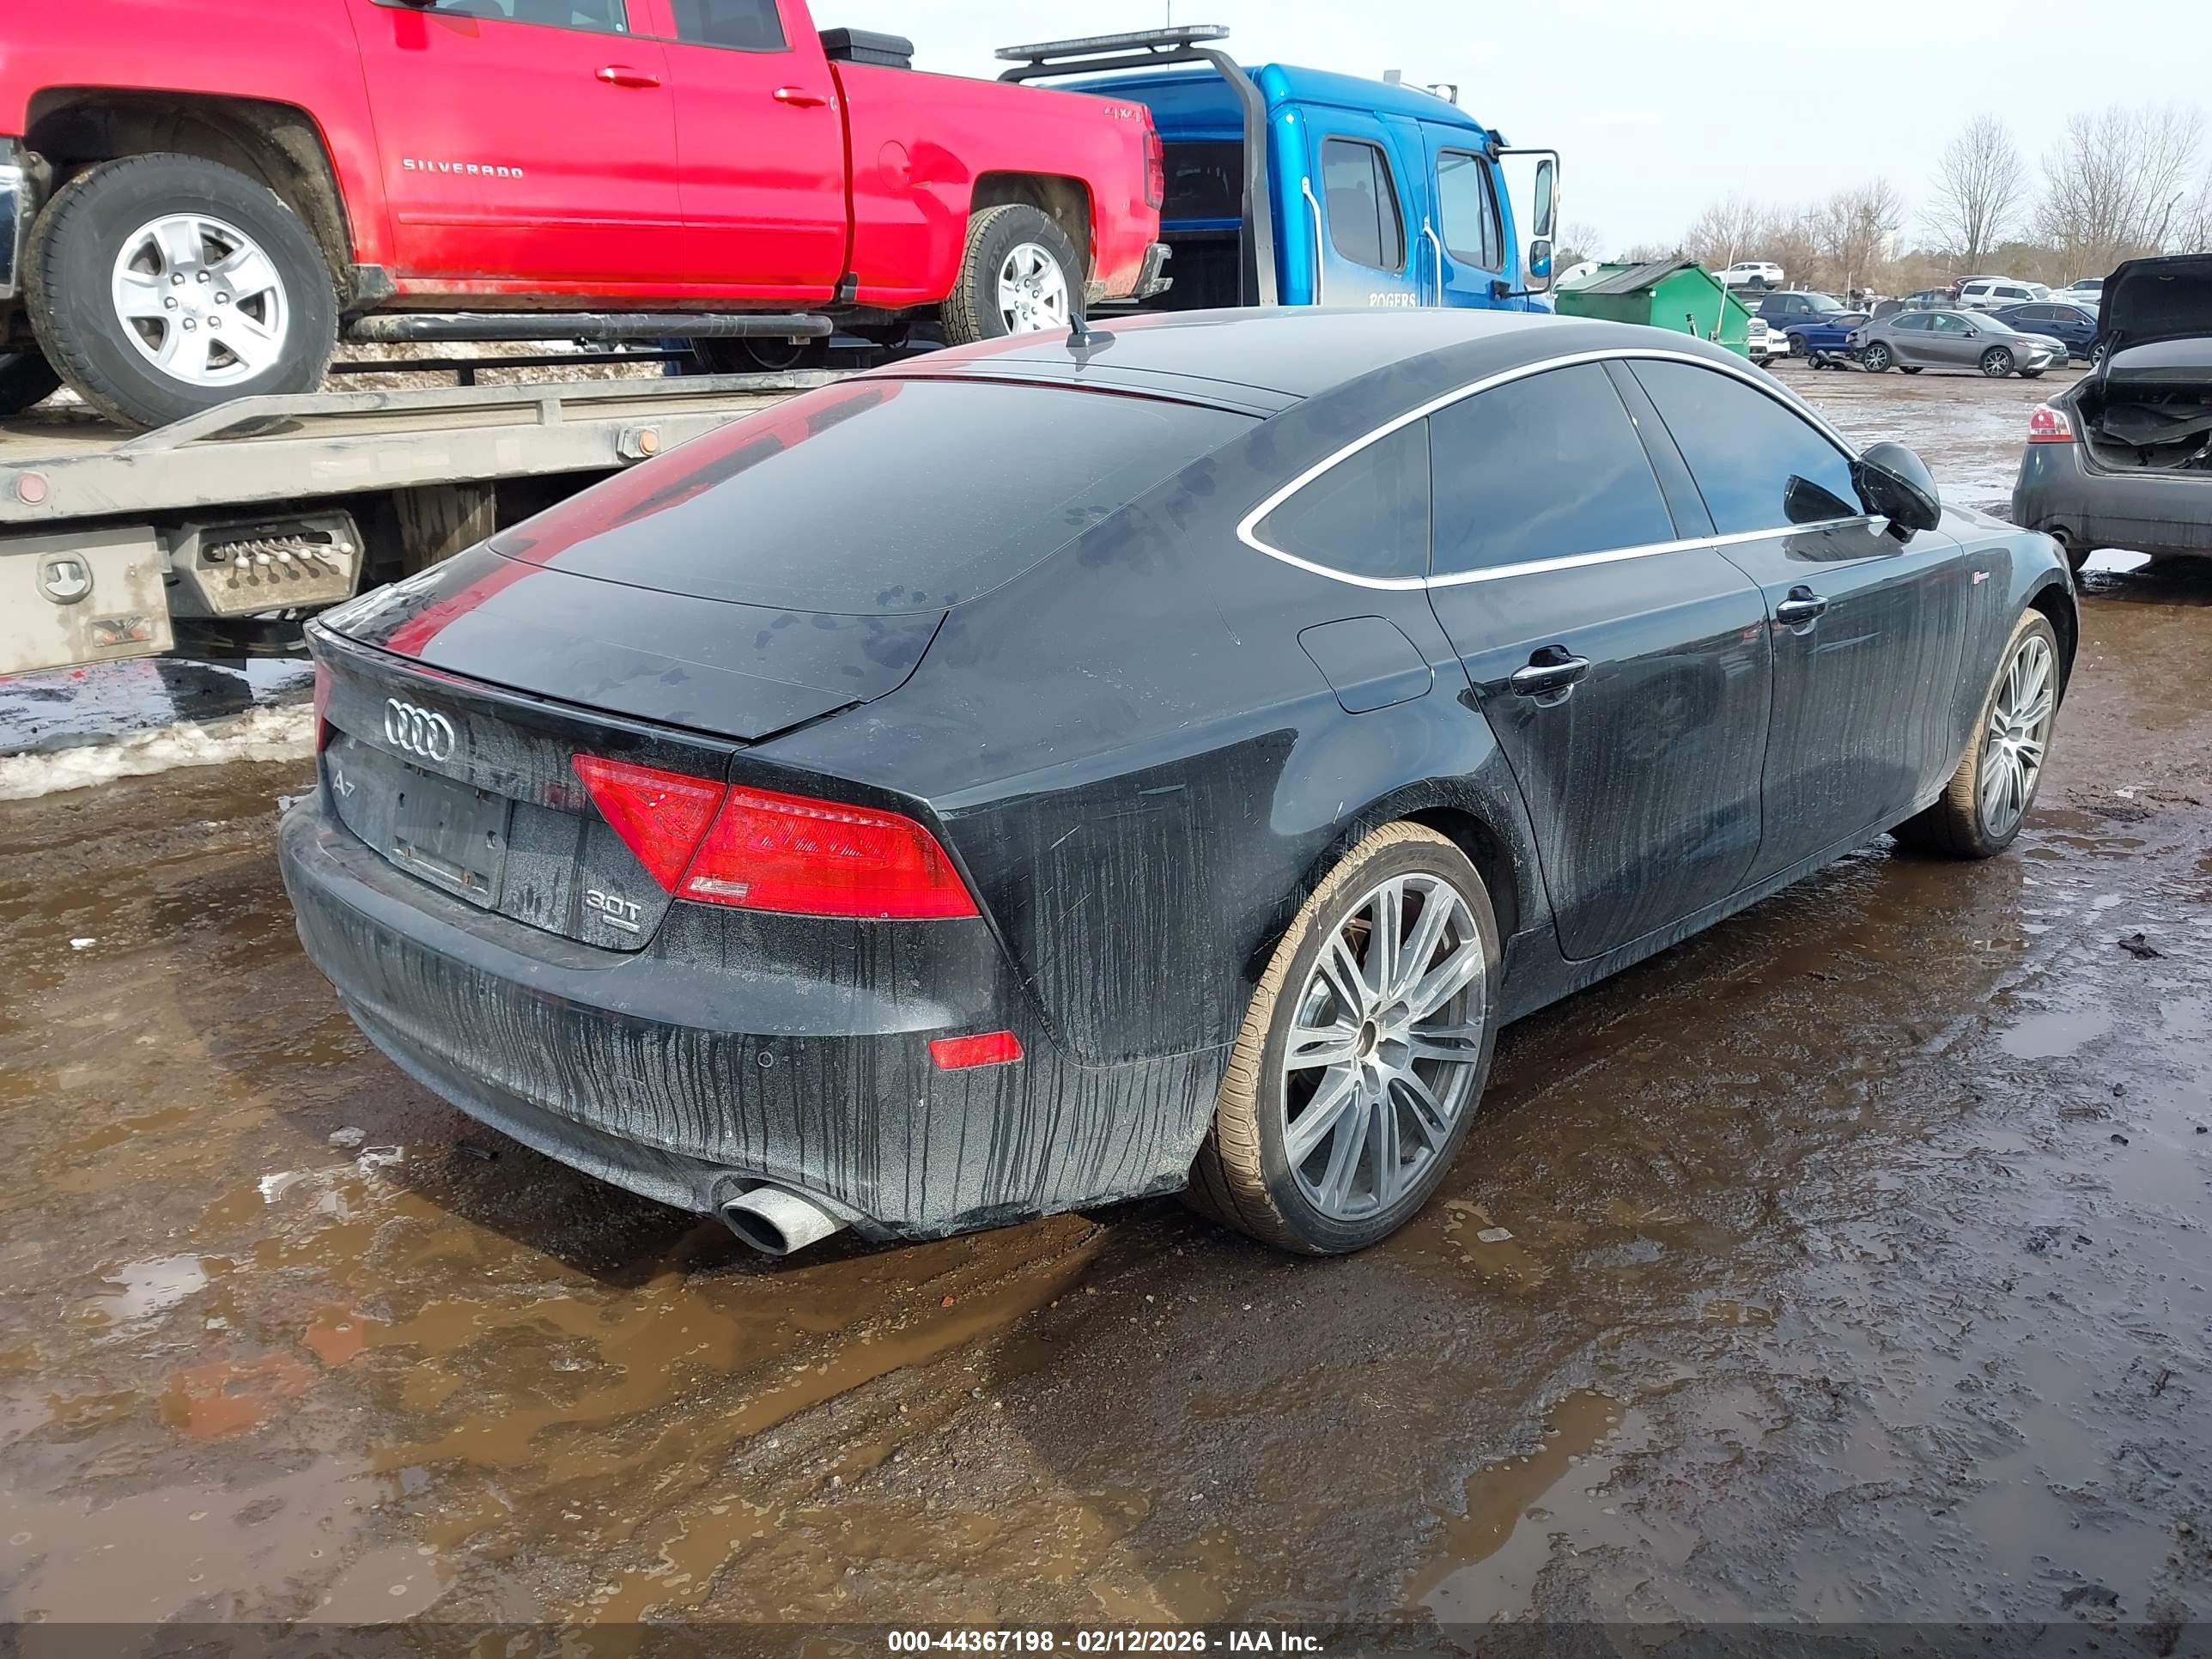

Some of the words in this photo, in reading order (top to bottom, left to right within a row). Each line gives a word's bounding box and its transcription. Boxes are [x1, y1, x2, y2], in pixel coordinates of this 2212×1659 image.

[403, 158, 524, 179] SILVERADO
[1369, 292, 1416, 307] ROGERS
[332, 769, 356, 798] A7
